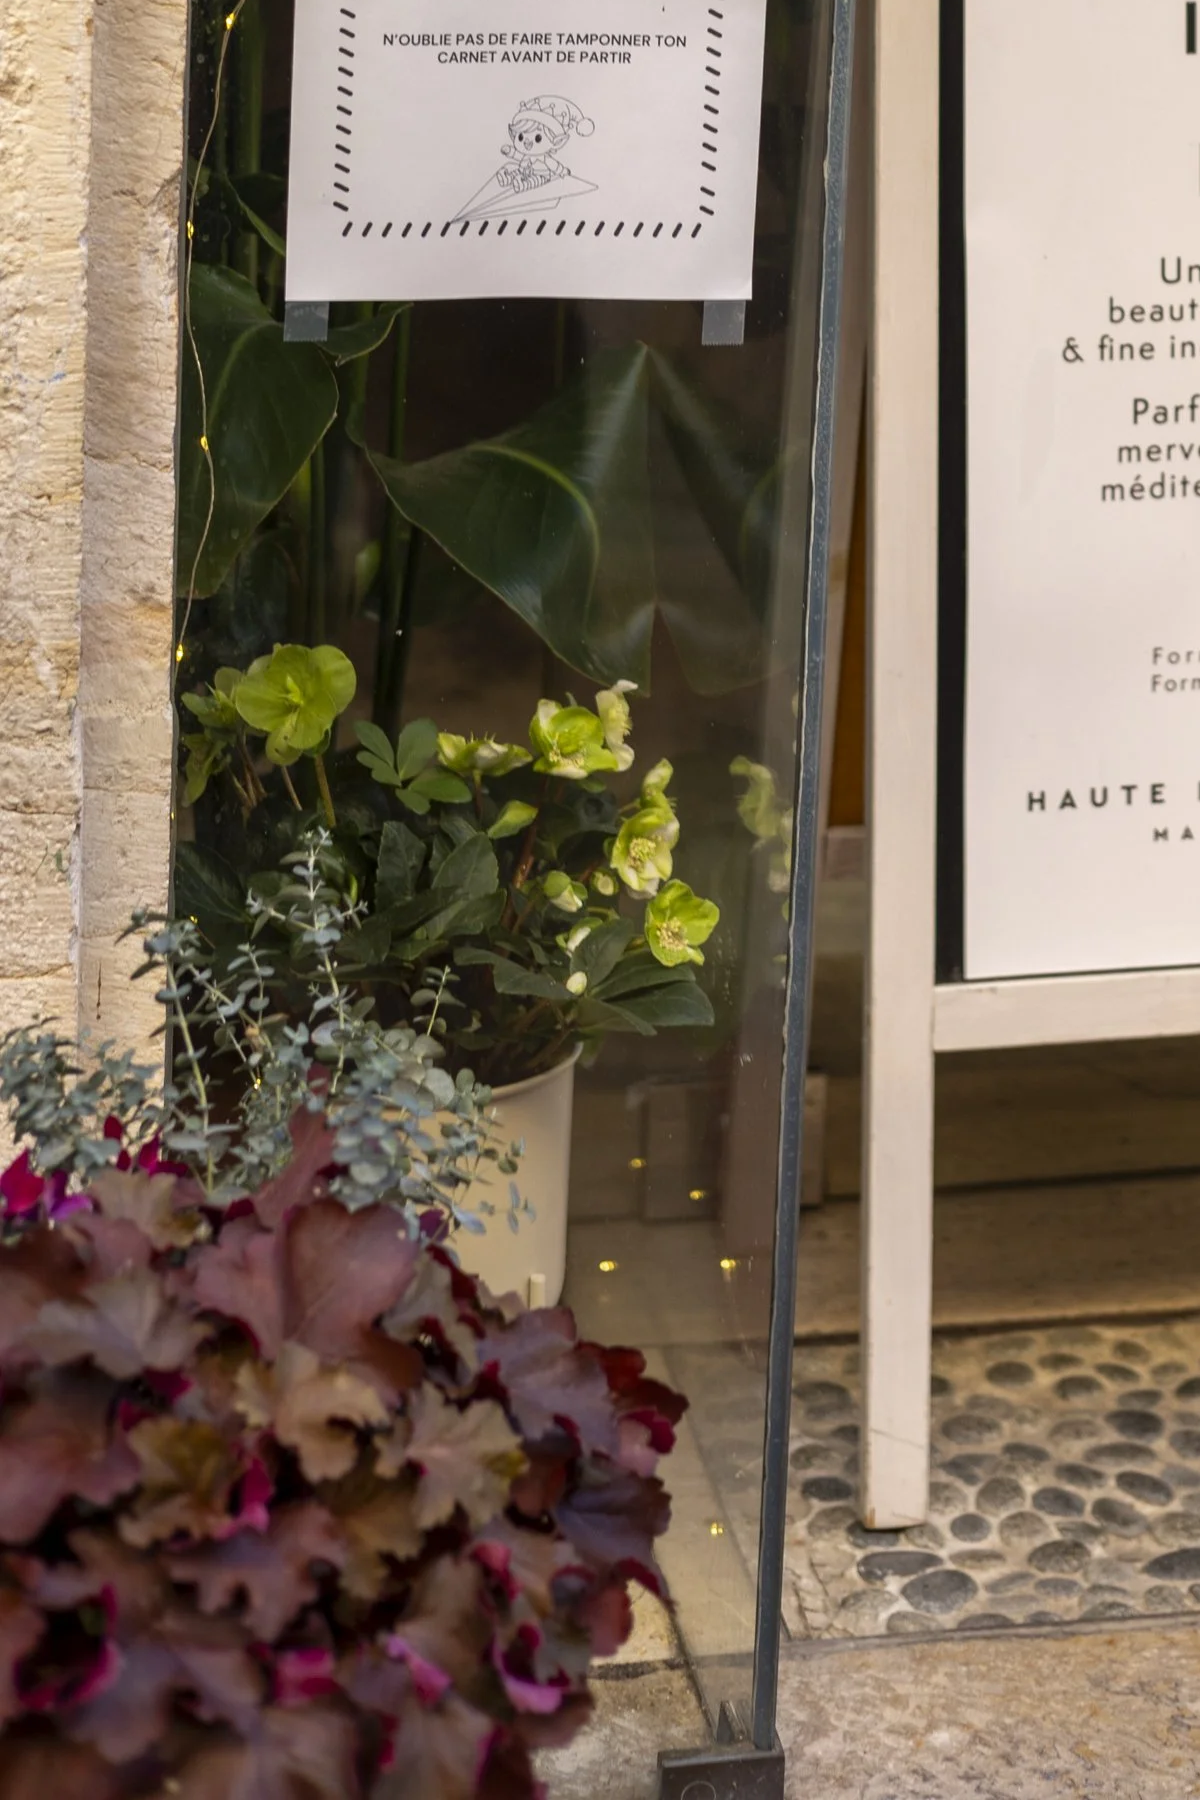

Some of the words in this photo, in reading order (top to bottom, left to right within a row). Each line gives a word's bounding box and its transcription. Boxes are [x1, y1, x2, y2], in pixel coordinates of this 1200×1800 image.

[383, 33, 452, 47] N'OUBLIE
[455, 33, 485, 46] PAS
[488, 32, 508, 46] DE
[511, 32, 552, 45] FAIRE
[556, 33, 651, 47] TAMPONNER
[655, 34, 687, 48] TON
[437, 50, 497, 64] CARNET
[500, 50, 553, 63] AVANT
[556, 50, 576, 63] DE
[579, 51, 632, 64] PARTIR
[1062, 336, 1084, 364] &
[1097, 333, 1155, 362] fine
[1027, 782, 1165, 812] HAUTE
